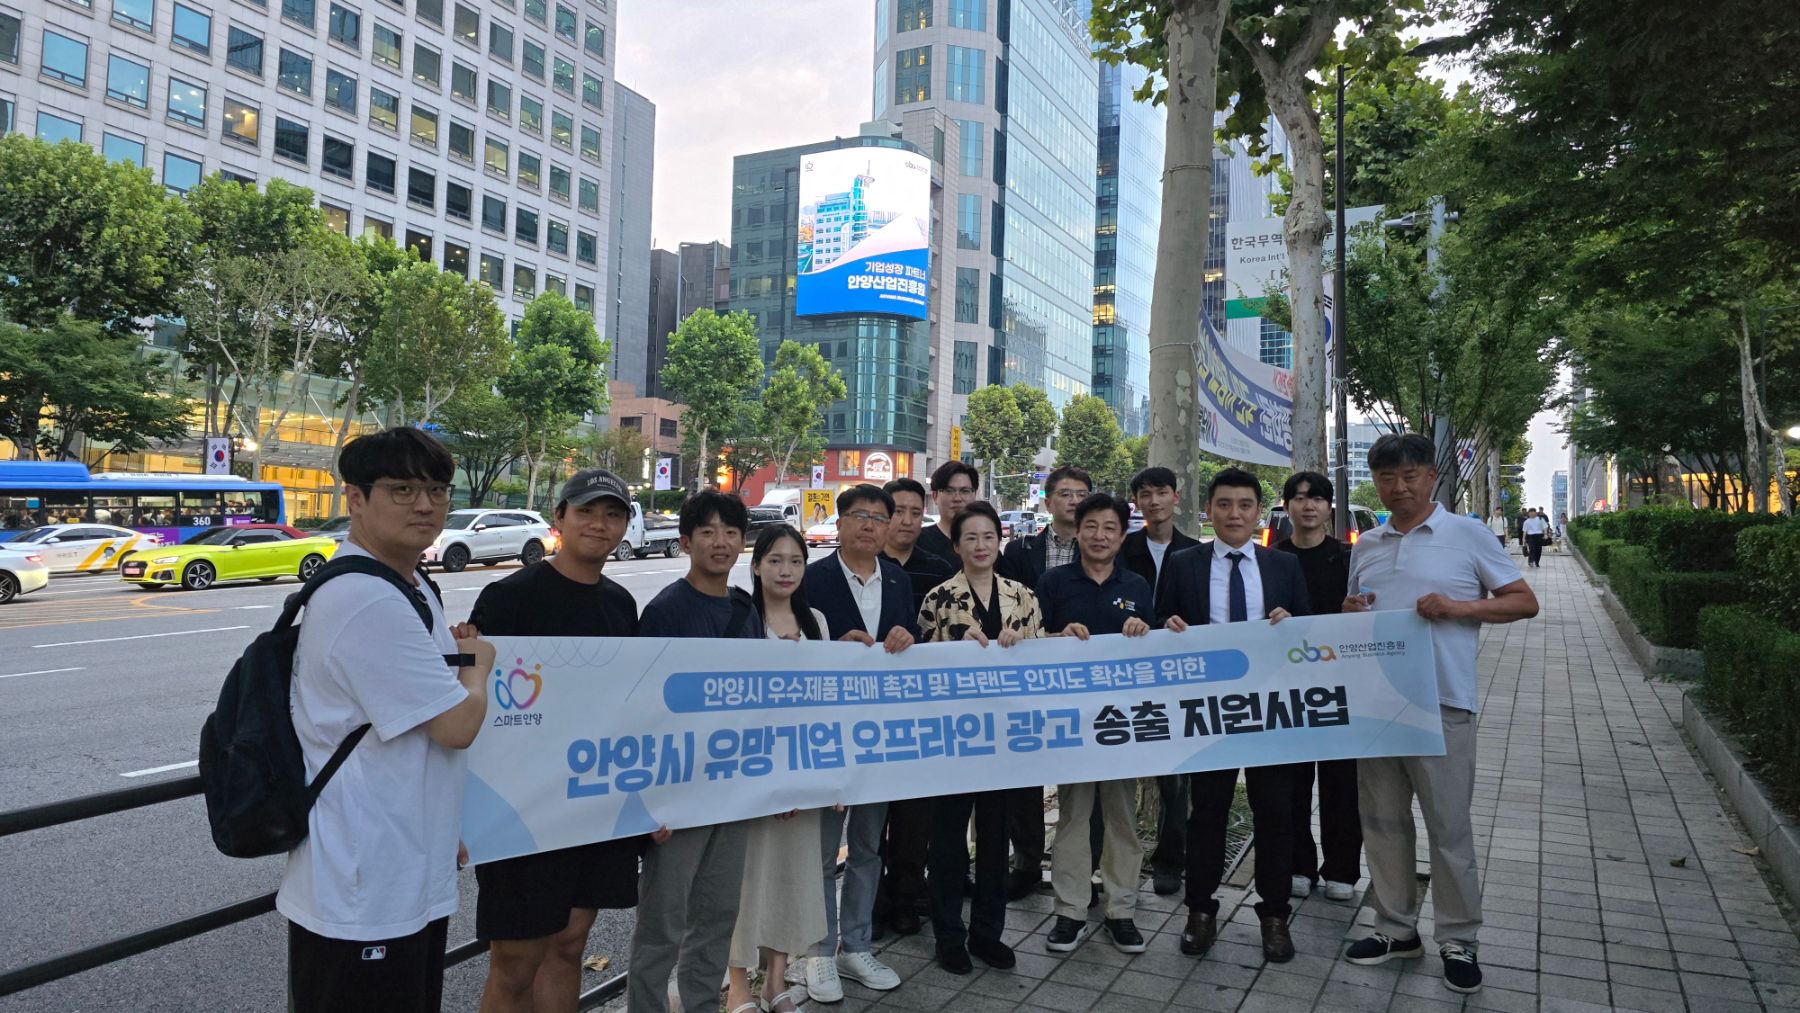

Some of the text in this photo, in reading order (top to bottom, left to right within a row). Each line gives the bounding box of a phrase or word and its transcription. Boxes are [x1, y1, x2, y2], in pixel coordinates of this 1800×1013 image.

[1240, 253, 1266, 264] Korea
[865, 261, 926, 281] 기업성장 파트너
[847, 275, 926, 297] 안양산업진흥원
[587, 476, 598, 487] LOS
[193, 516, 211, 526] 360
[1339, 641, 1406, 654] 안양산업진흥원
[703, 656, 1206, 706] 안양시 우수제품 판매 촉진 및 브랜드 인지도 확산을 위한
[493, 713, 543, 727] 스마트안양
[566, 685, 1349, 799] 안양시 유망기업 오프라인 광고 송출 지원사업
